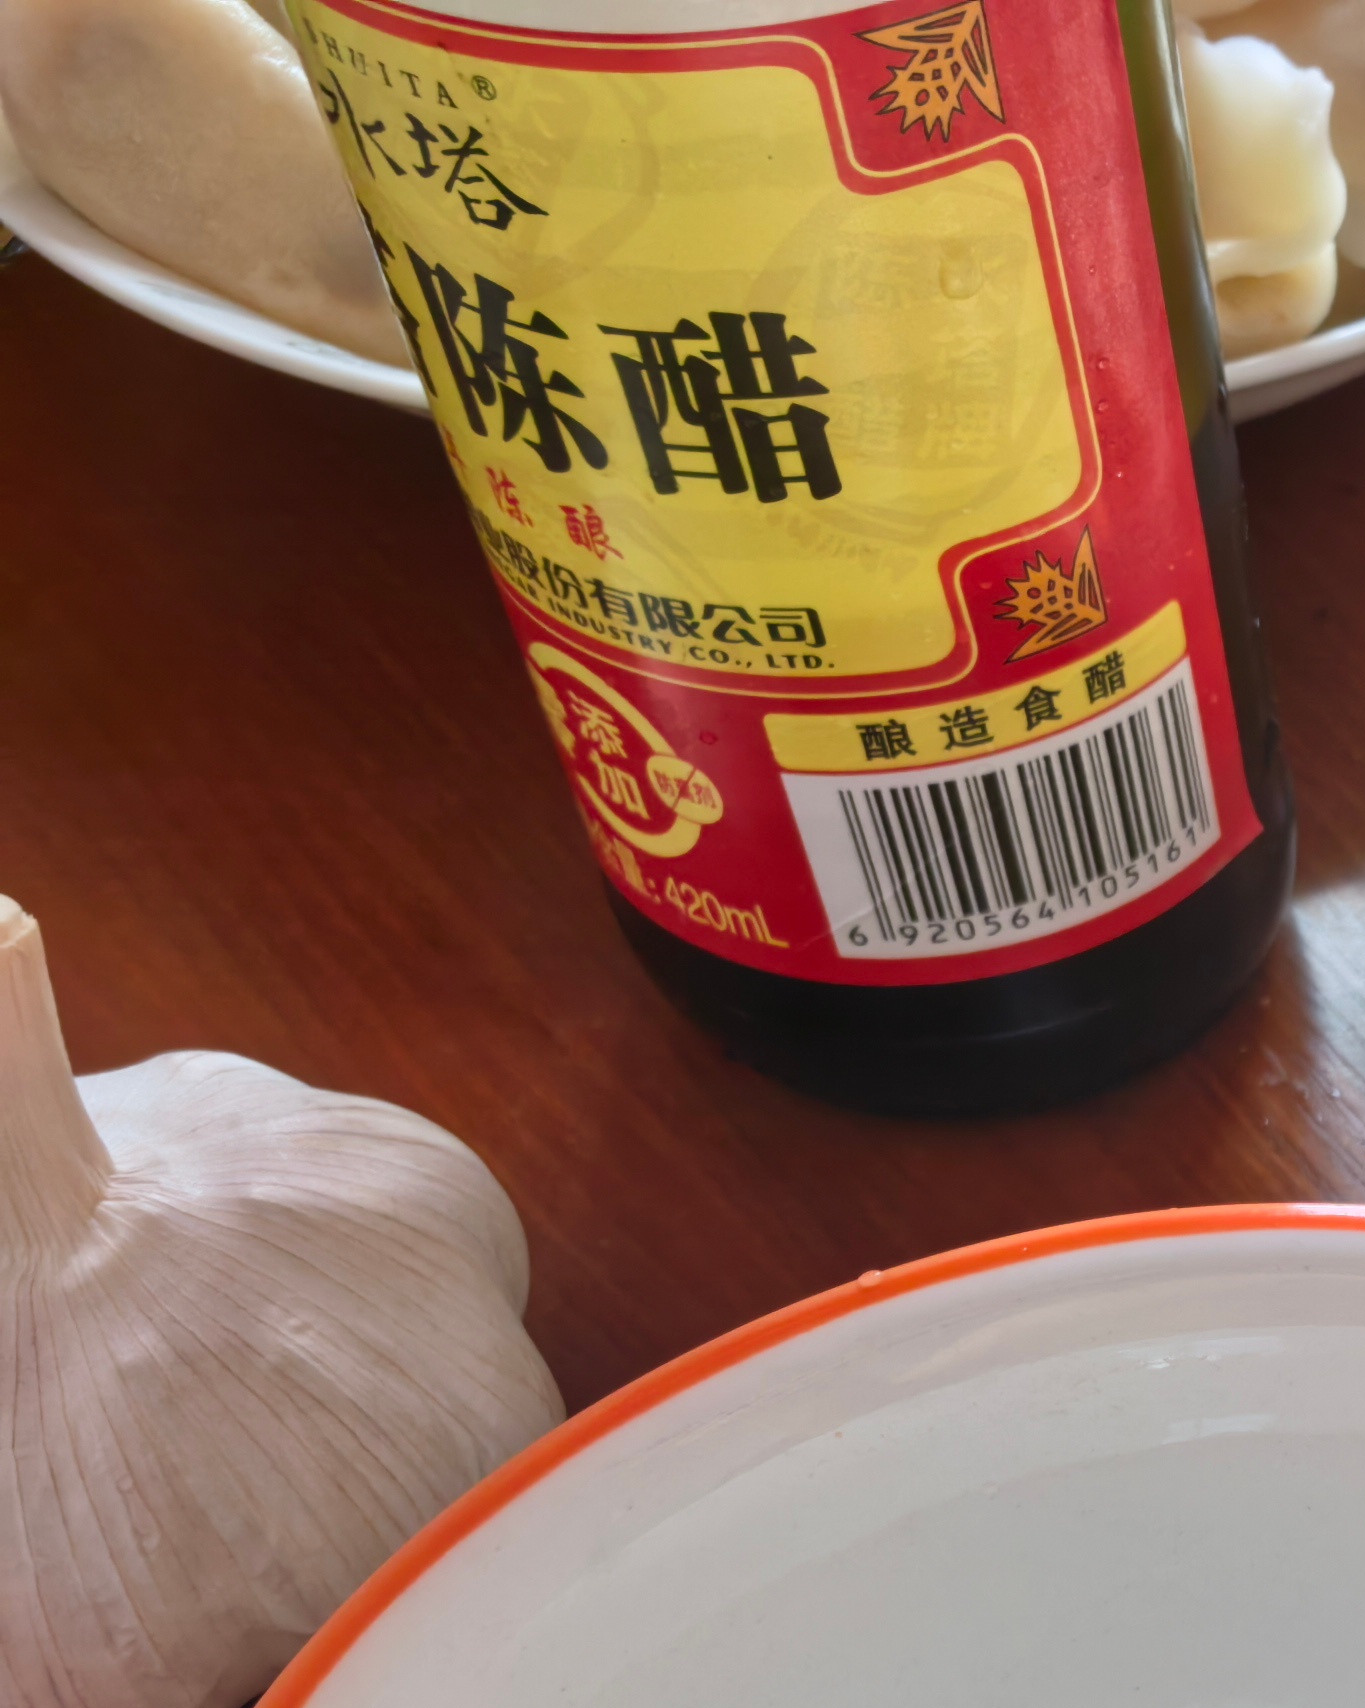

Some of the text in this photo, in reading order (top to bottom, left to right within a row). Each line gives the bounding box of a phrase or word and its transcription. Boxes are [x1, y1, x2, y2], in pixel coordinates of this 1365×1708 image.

[317, 67, 549, 231] 水塔
[357, 199, 842, 503] 陈醋
[548, 597, 673, 656] INDUSTRY
[766, 653, 835, 669] LTD.
[856, 651, 1127, 762] 酿造食醋
